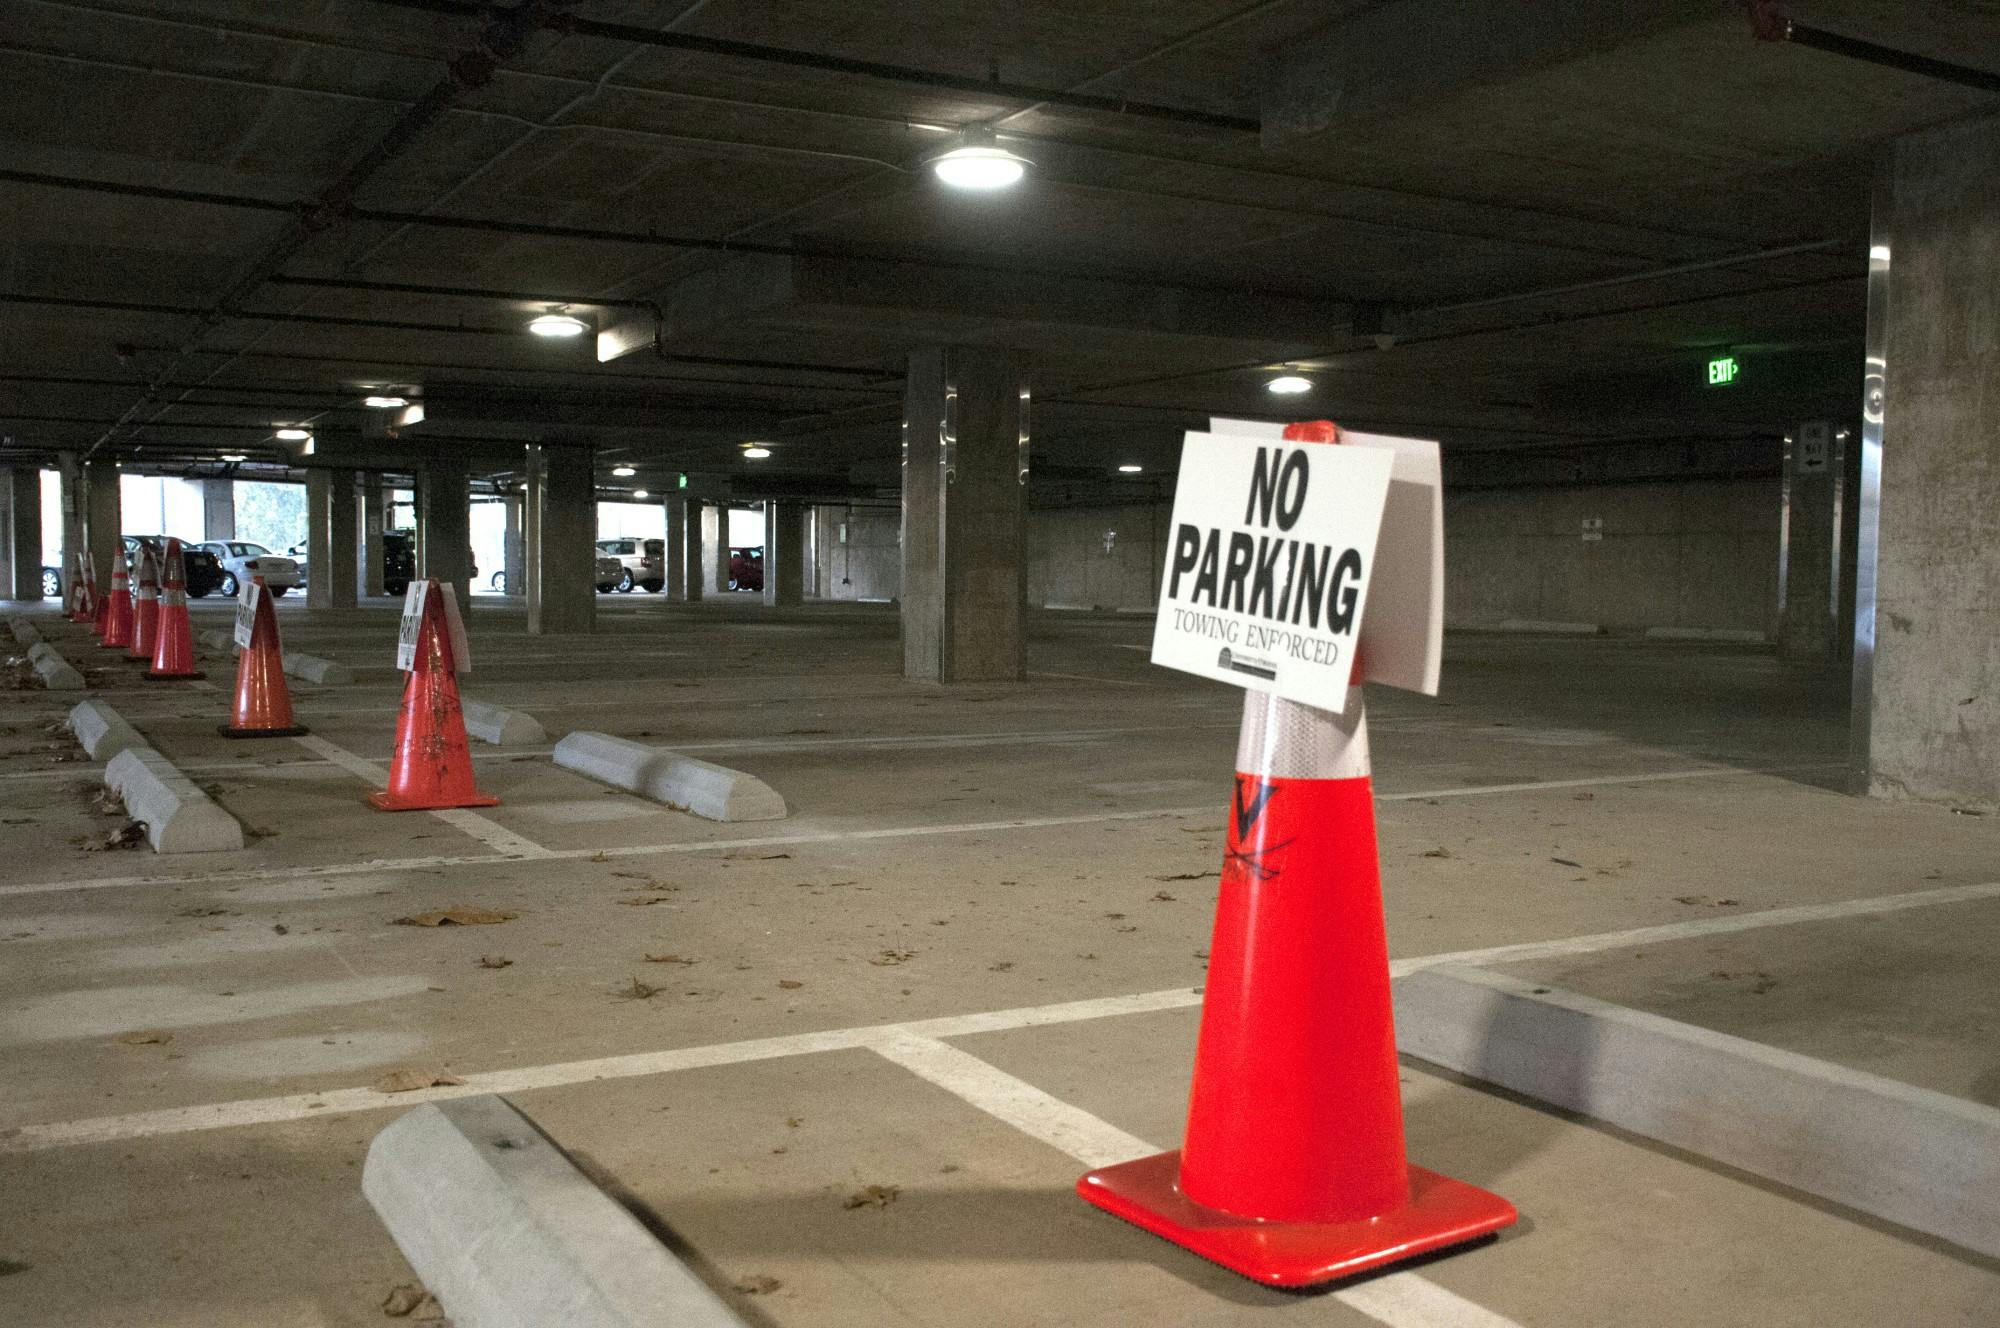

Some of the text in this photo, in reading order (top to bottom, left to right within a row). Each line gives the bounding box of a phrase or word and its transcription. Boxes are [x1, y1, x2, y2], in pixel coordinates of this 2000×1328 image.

[1709, 358, 1733, 384] EXIT
[1245, 446, 1310, 532] NO
[1168, 523, 1363, 637] PARKING
[1174, 607, 1239, 644] TOWING
[1246, 624, 1339, 667] ENFORCED
